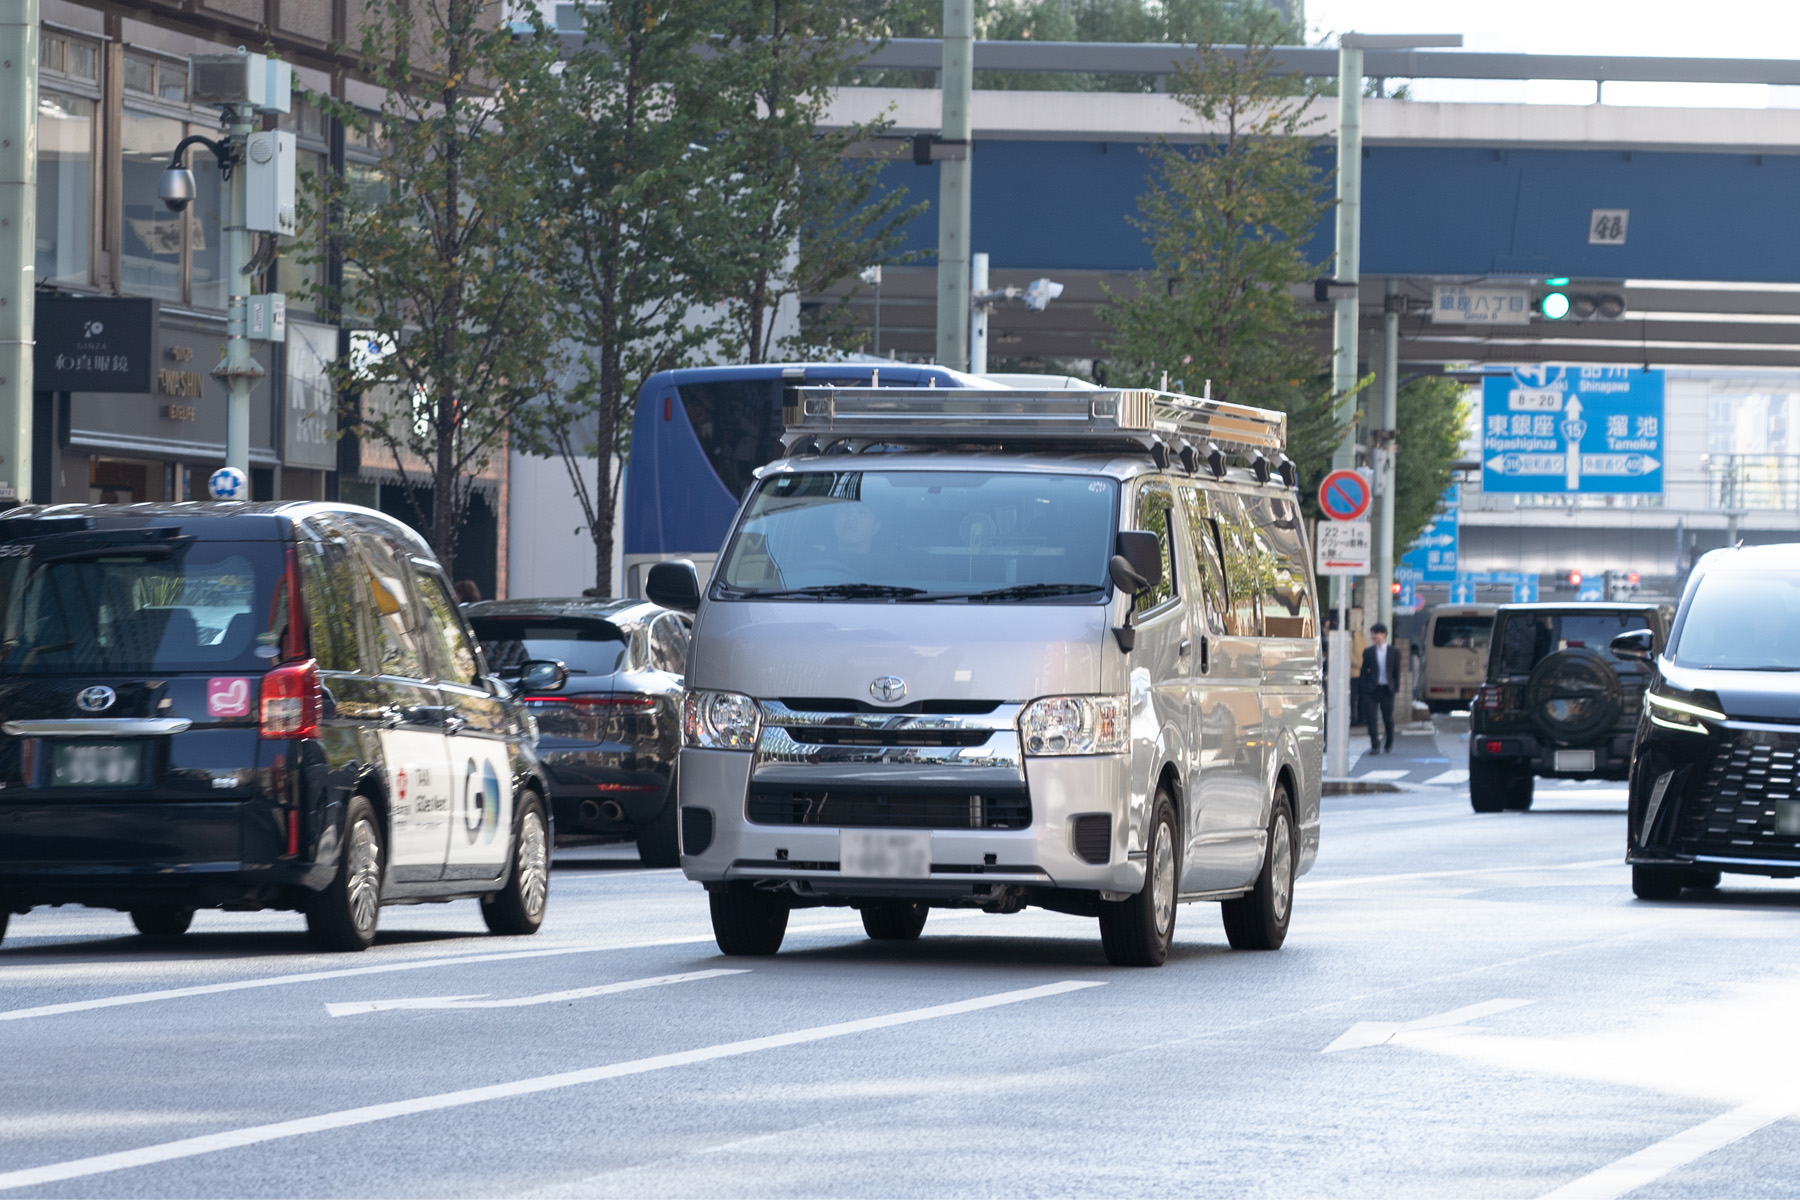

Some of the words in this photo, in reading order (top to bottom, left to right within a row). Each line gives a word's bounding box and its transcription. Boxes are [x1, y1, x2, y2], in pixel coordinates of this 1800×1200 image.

[1440, 296, 1523, 312] 銀座八丁目
[1580, 381, 1629, 393] Shinagawa
[1487, 414, 1554, 437] 東銀座
[1566, 423, 1581, 438] 15
[1485, 437, 1557, 451] Higashiginza
[1608, 438, 1657, 451] Tameike
